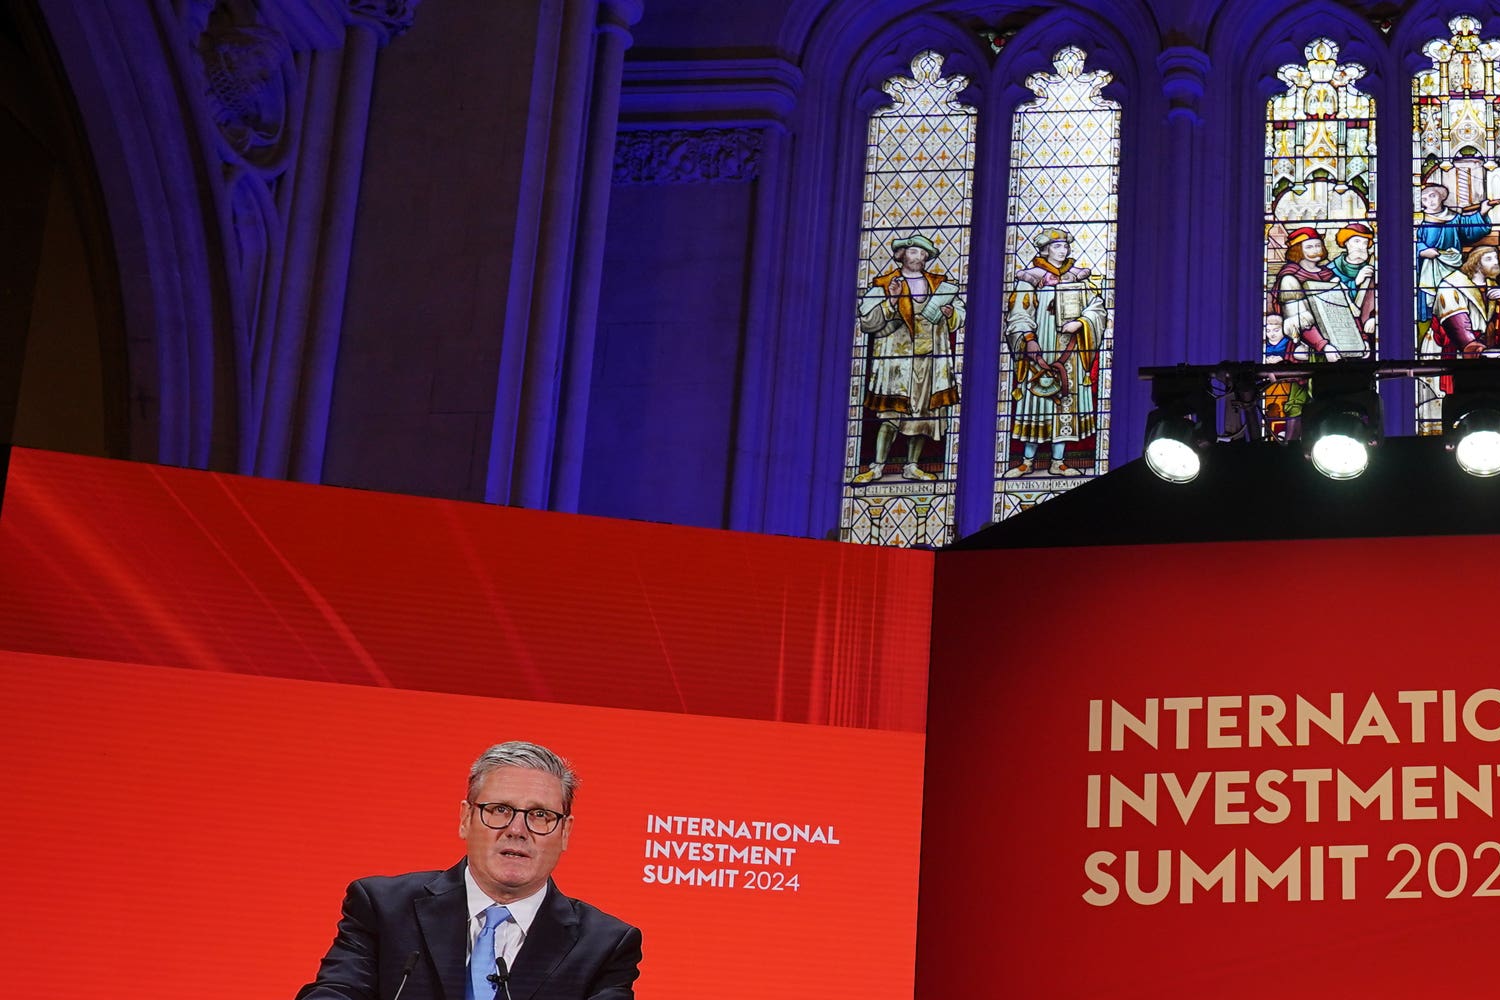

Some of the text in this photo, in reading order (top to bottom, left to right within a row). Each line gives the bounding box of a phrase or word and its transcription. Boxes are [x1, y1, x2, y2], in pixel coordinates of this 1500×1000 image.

[866, 484, 934, 494] GUTENBERG
[646, 814, 840, 846] INTERNATIONAL
[644, 839, 797, 867] INVESTMENT
[642, 864, 802, 892] SUMMIT 2024
[1081, 844, 1370, 908] SUMMIT
